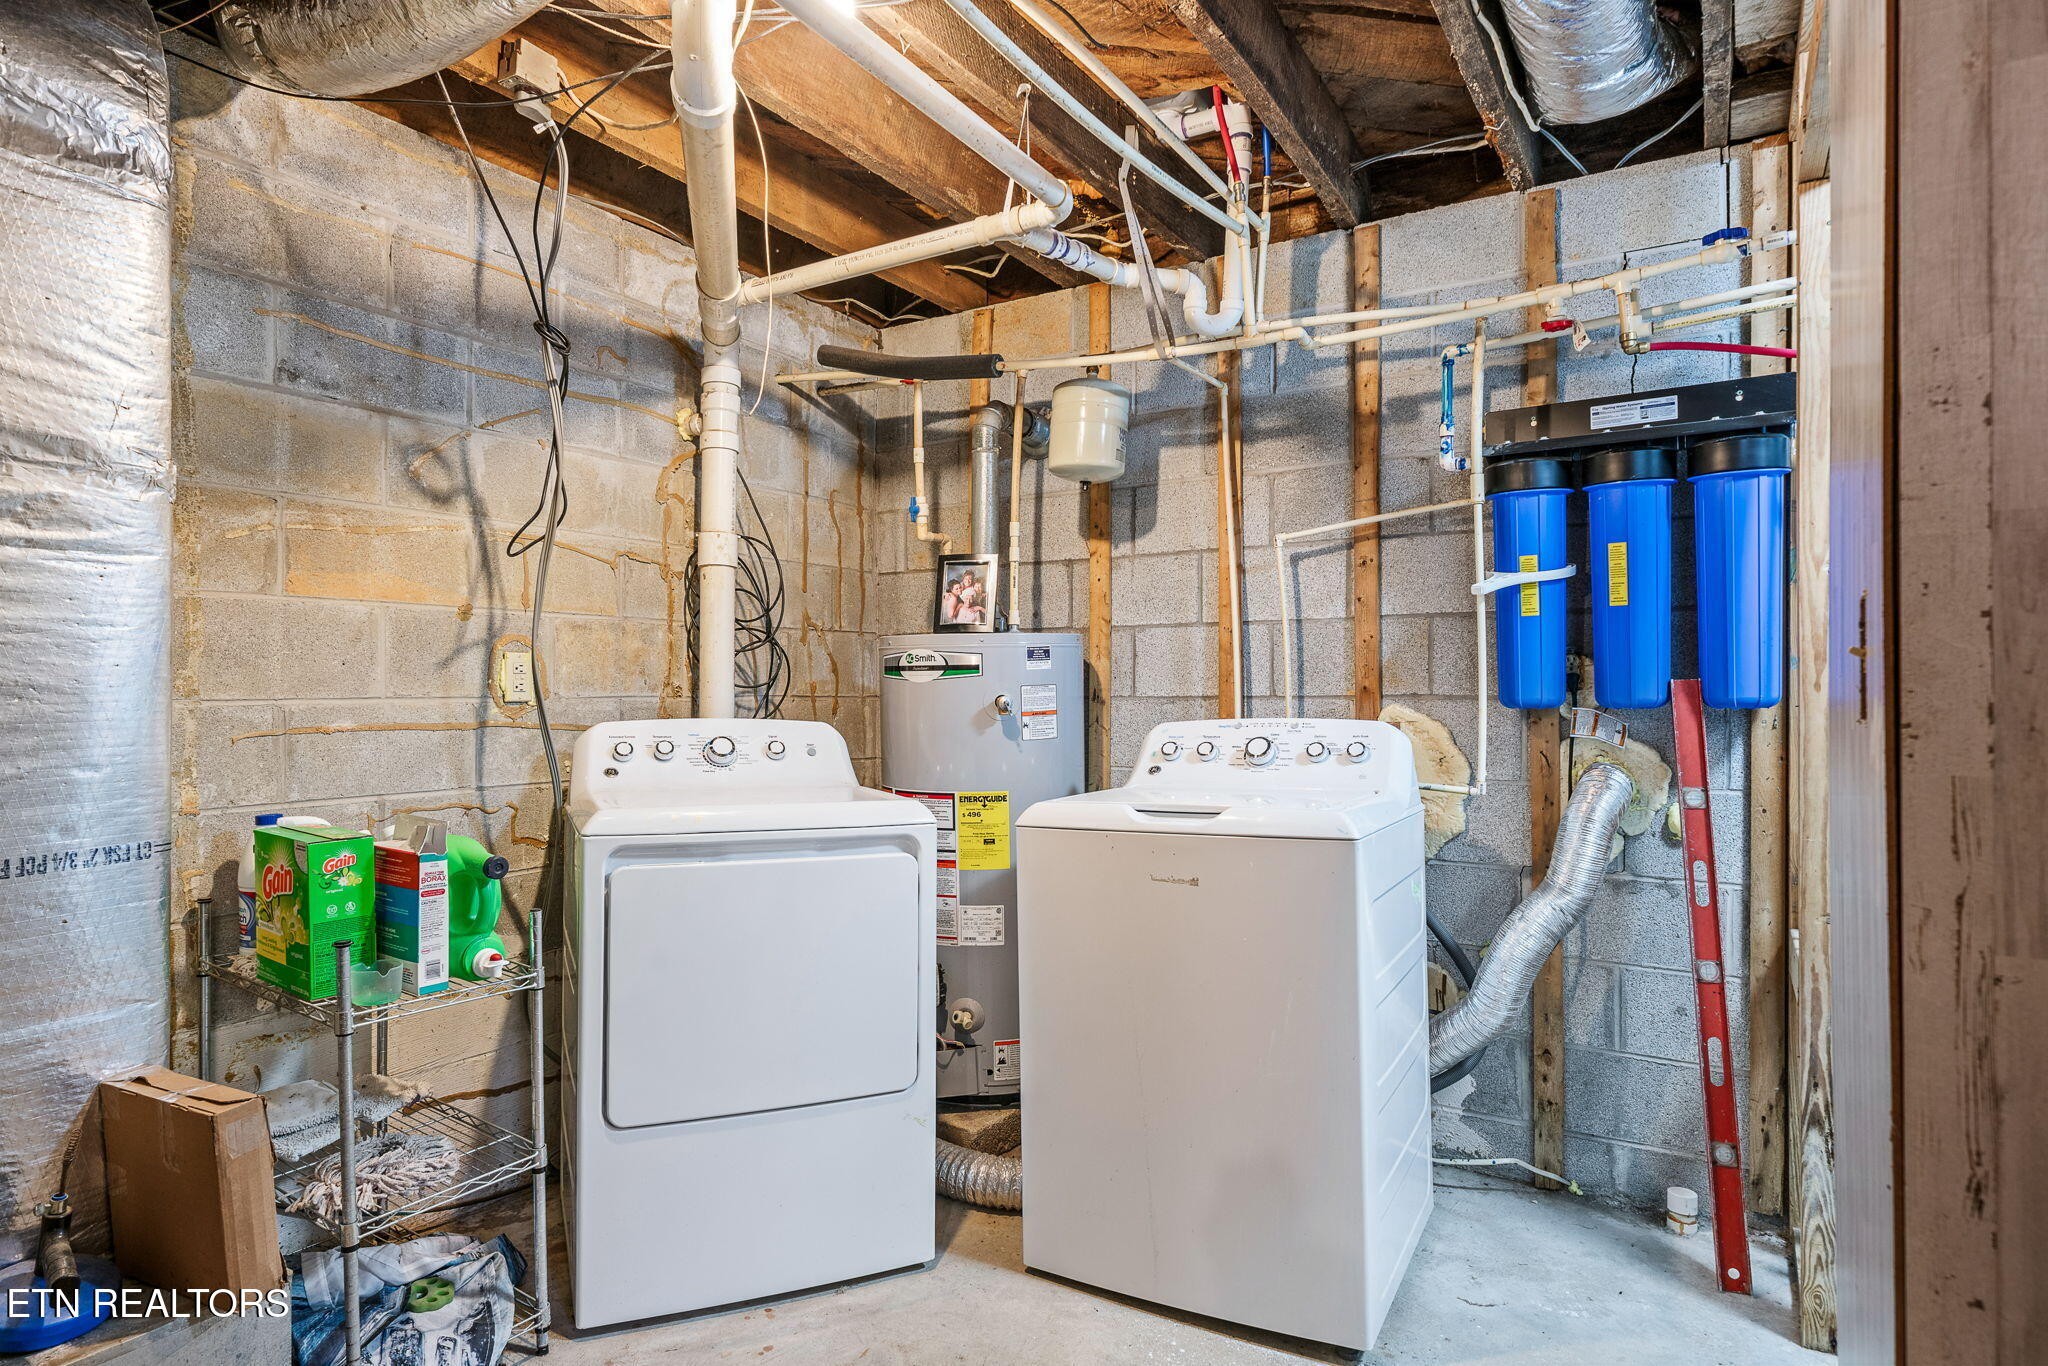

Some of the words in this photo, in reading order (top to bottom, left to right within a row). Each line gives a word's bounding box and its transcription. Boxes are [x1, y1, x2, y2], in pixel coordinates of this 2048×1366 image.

[914, 654, 936, 663] Smith
[959, 795, 1008, 803] ENERGYGUIDE
[15, 854, 48, 878] PCF
[323, 854, 357, 874] Gain
[262, 864, 294, 900] Gain
[421, 875, 447, 885] BORAX
